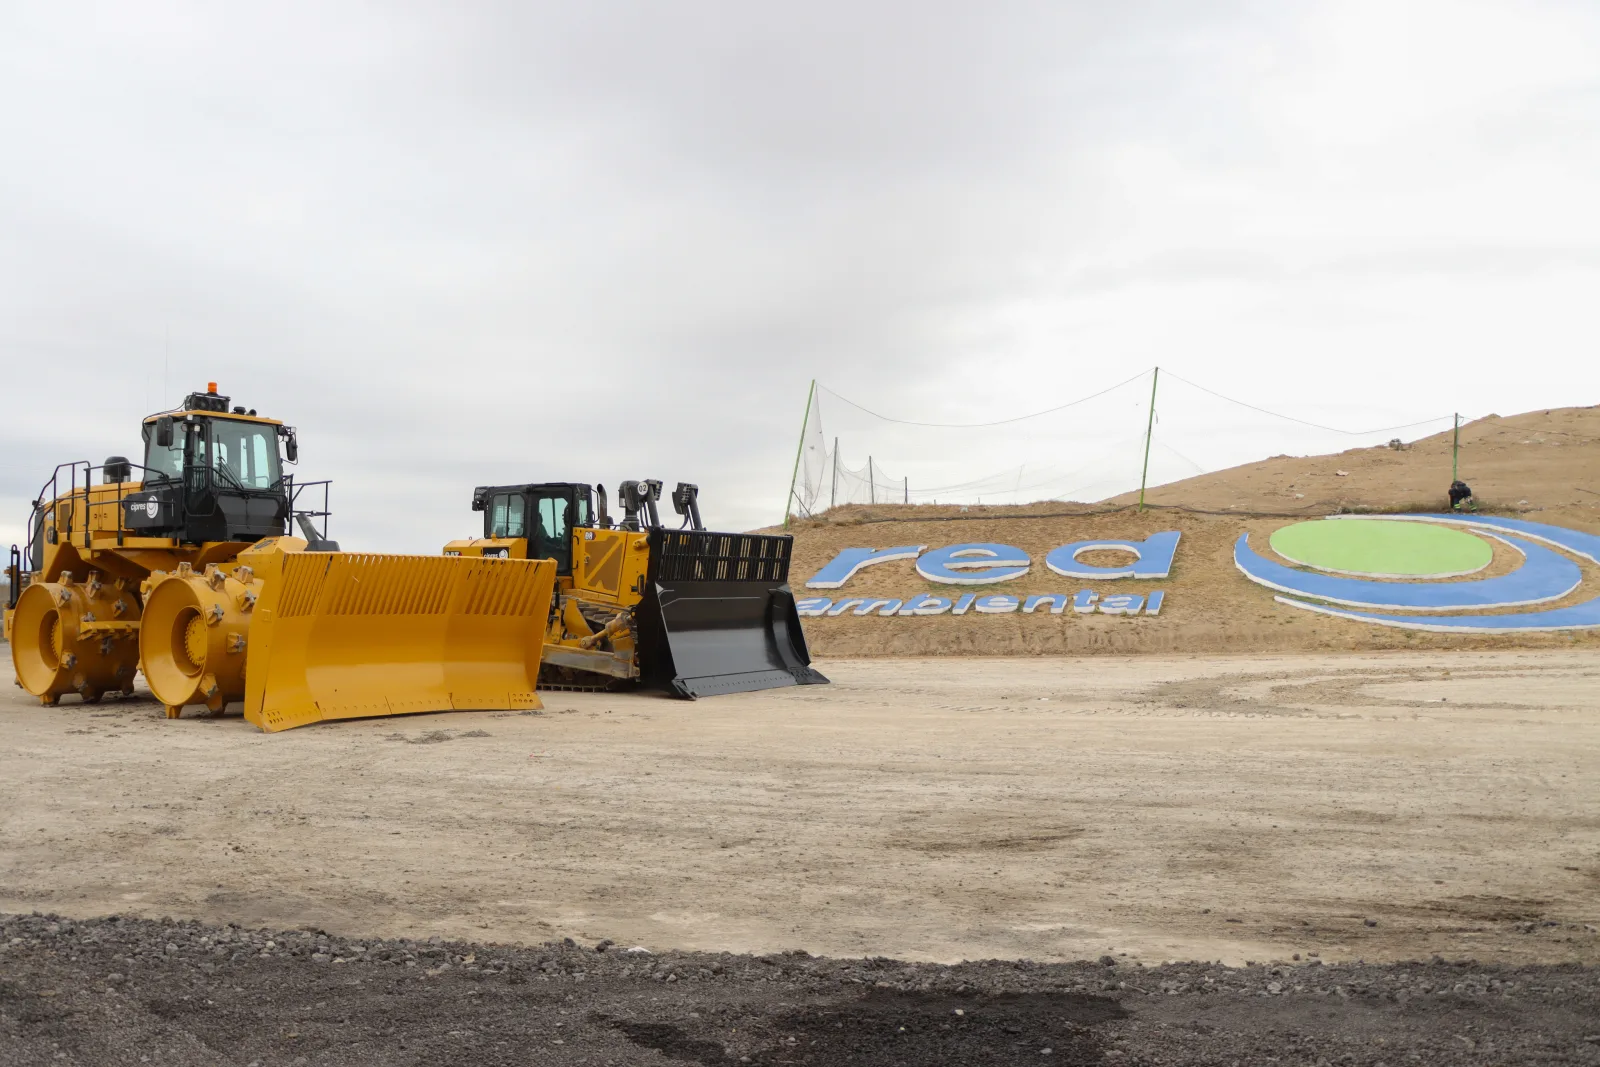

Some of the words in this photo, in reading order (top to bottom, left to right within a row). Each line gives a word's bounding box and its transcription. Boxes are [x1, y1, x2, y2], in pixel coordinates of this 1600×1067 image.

[639, 484, 647, 493] 02
[131, 503, 146, 512] cipres
[805, 531, 1182, 589] red
[797, 590, 1165, 617] ambiental
